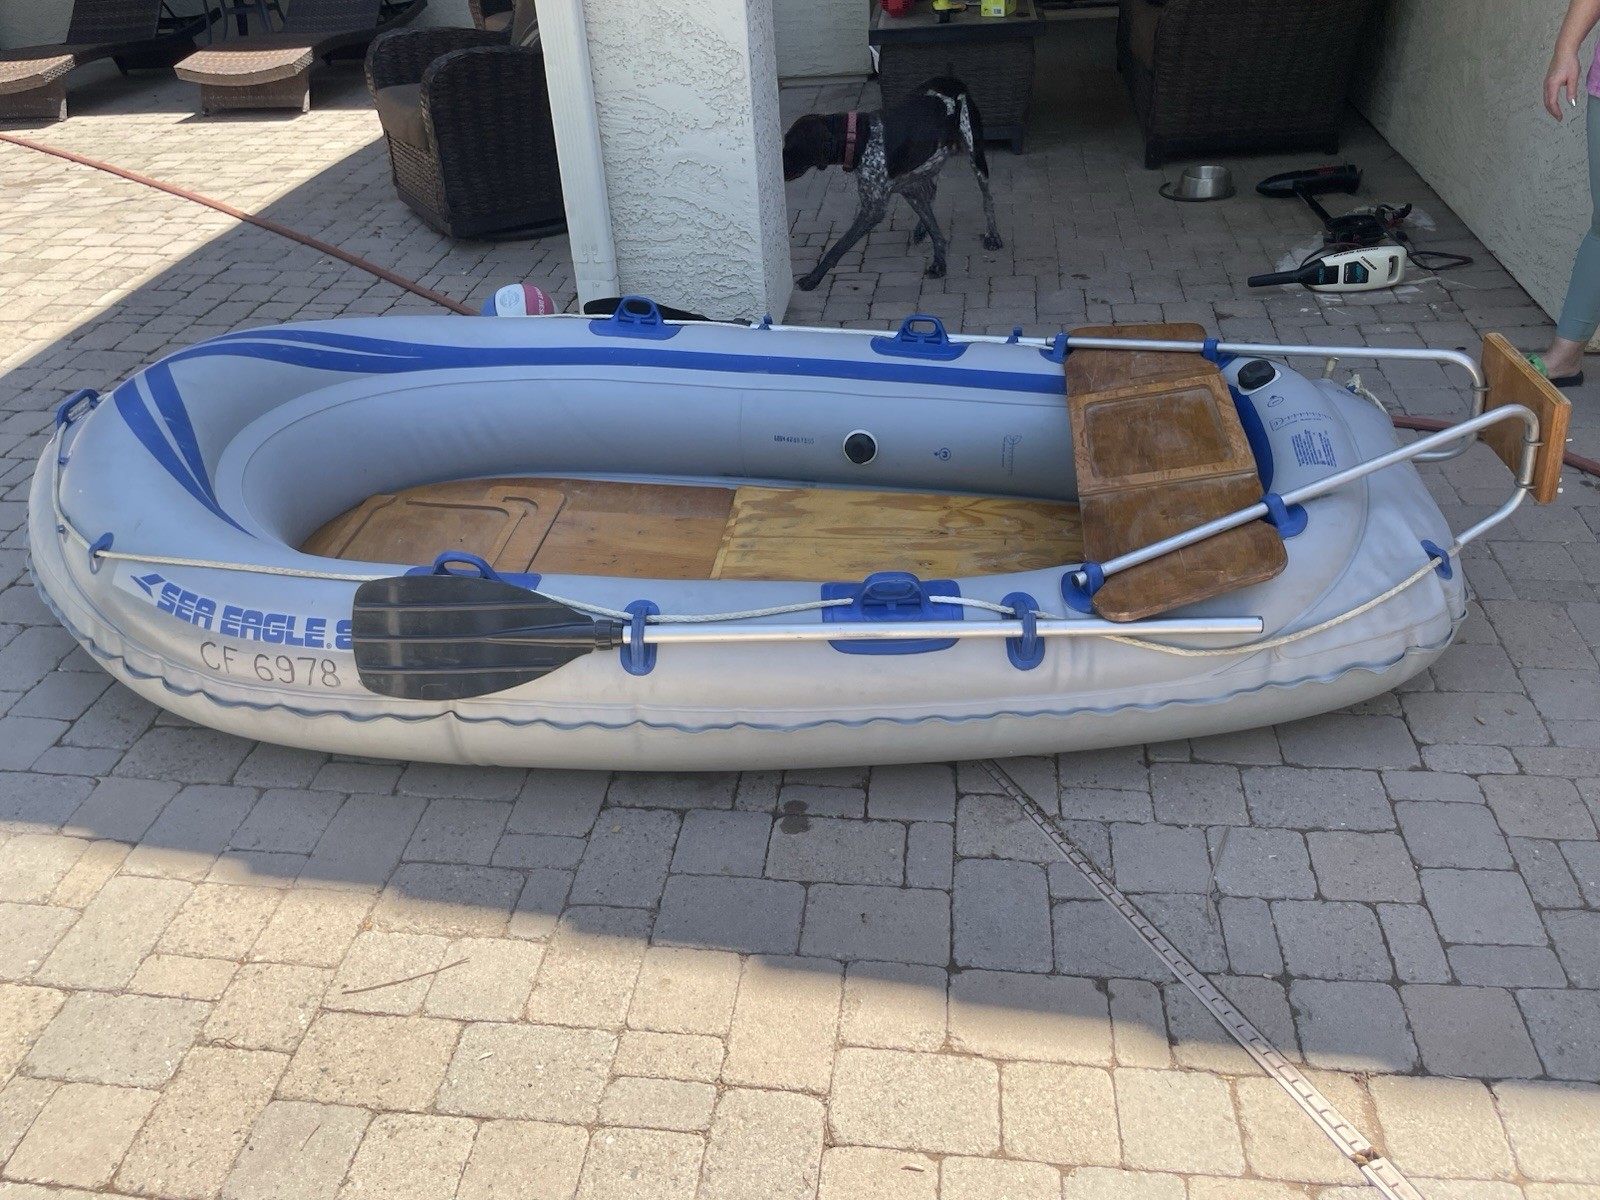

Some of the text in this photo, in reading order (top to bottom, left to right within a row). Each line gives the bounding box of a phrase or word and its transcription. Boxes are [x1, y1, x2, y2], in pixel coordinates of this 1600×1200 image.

[157, 582, 216, 630] SEA
[200, 641, 342, 688] CF 6978
